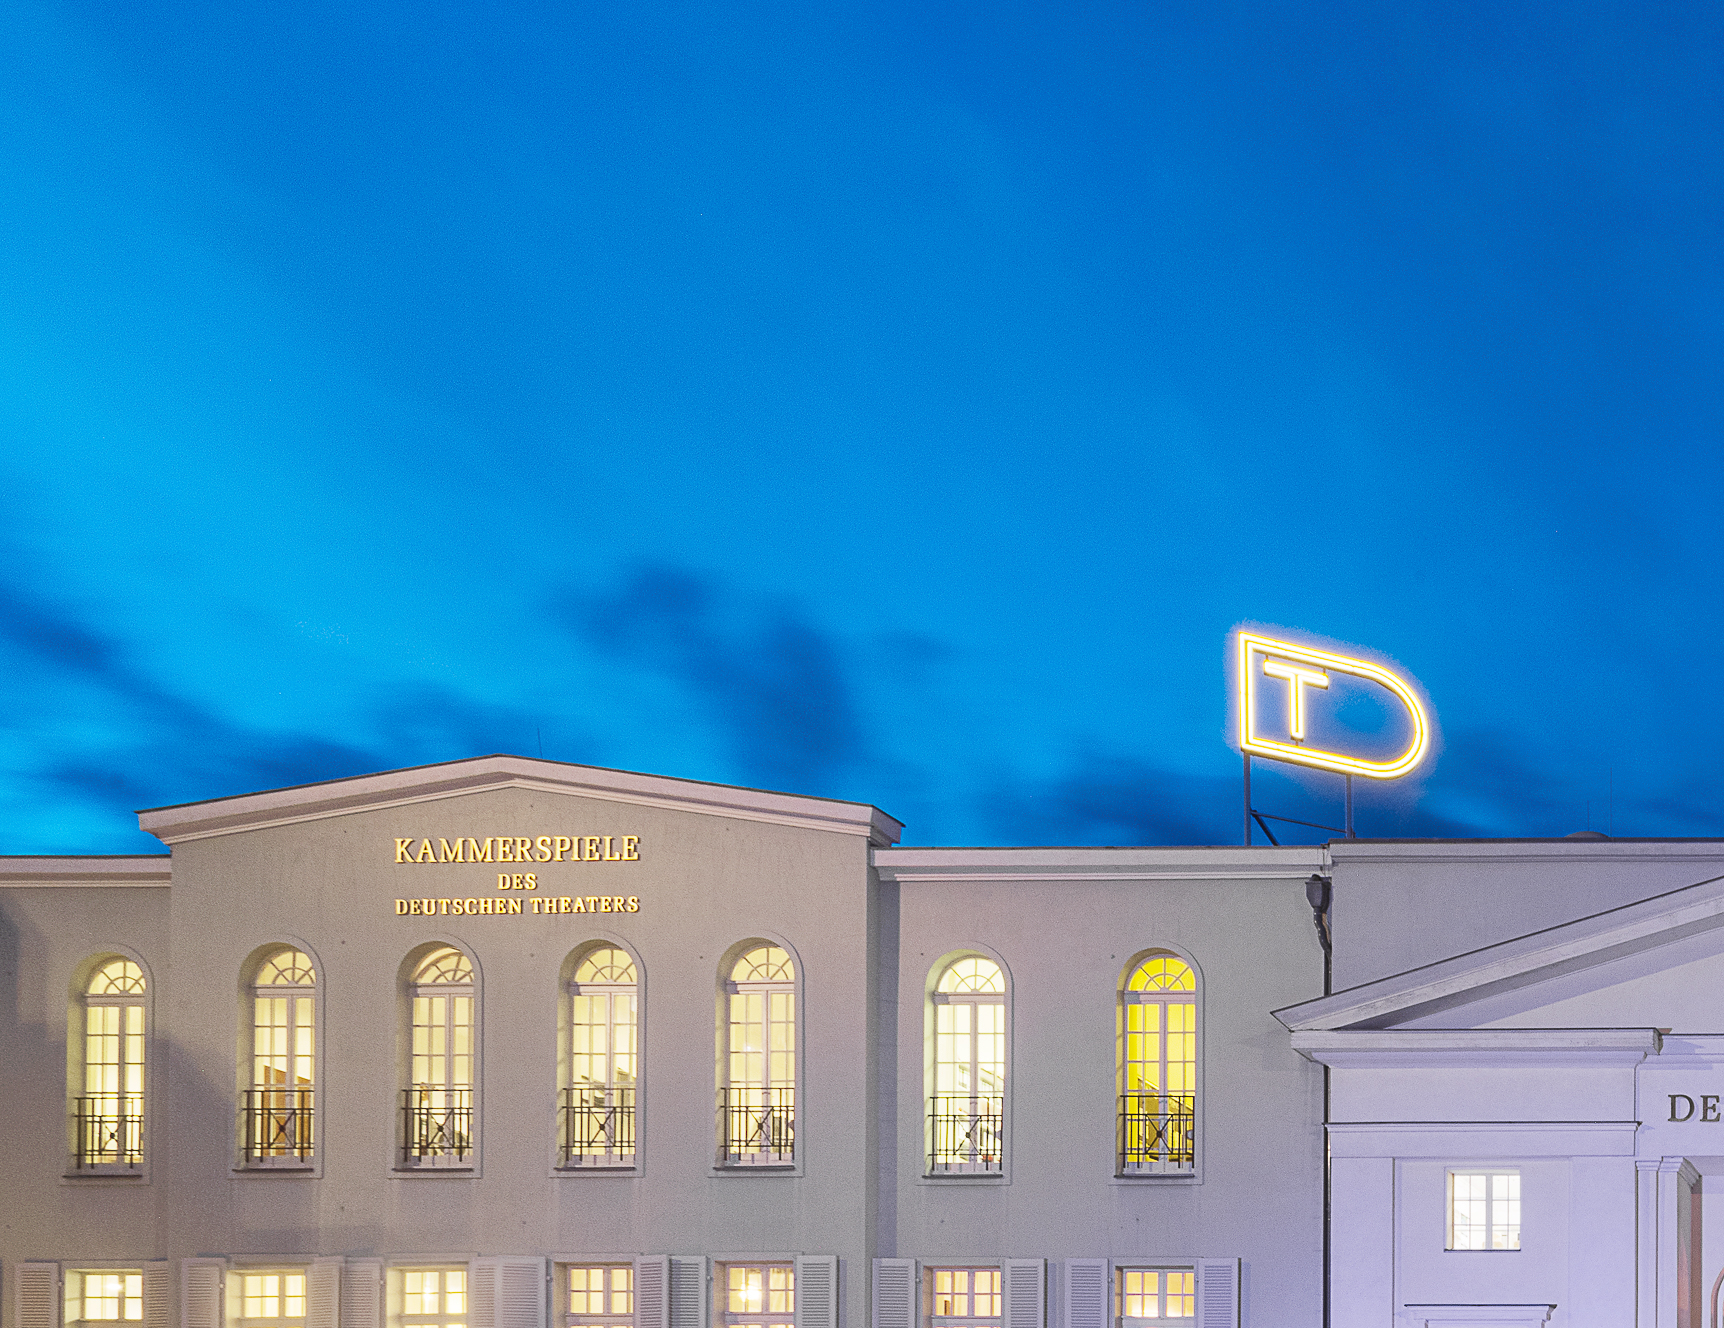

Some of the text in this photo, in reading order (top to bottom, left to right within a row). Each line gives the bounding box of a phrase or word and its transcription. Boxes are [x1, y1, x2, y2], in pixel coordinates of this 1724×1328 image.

[394, 835, 640, 863] KAMMERSPIELE
[497, 873, 538, 890] DES
[395, 896, 640, 915] DEUTSCHEN THEATERS
